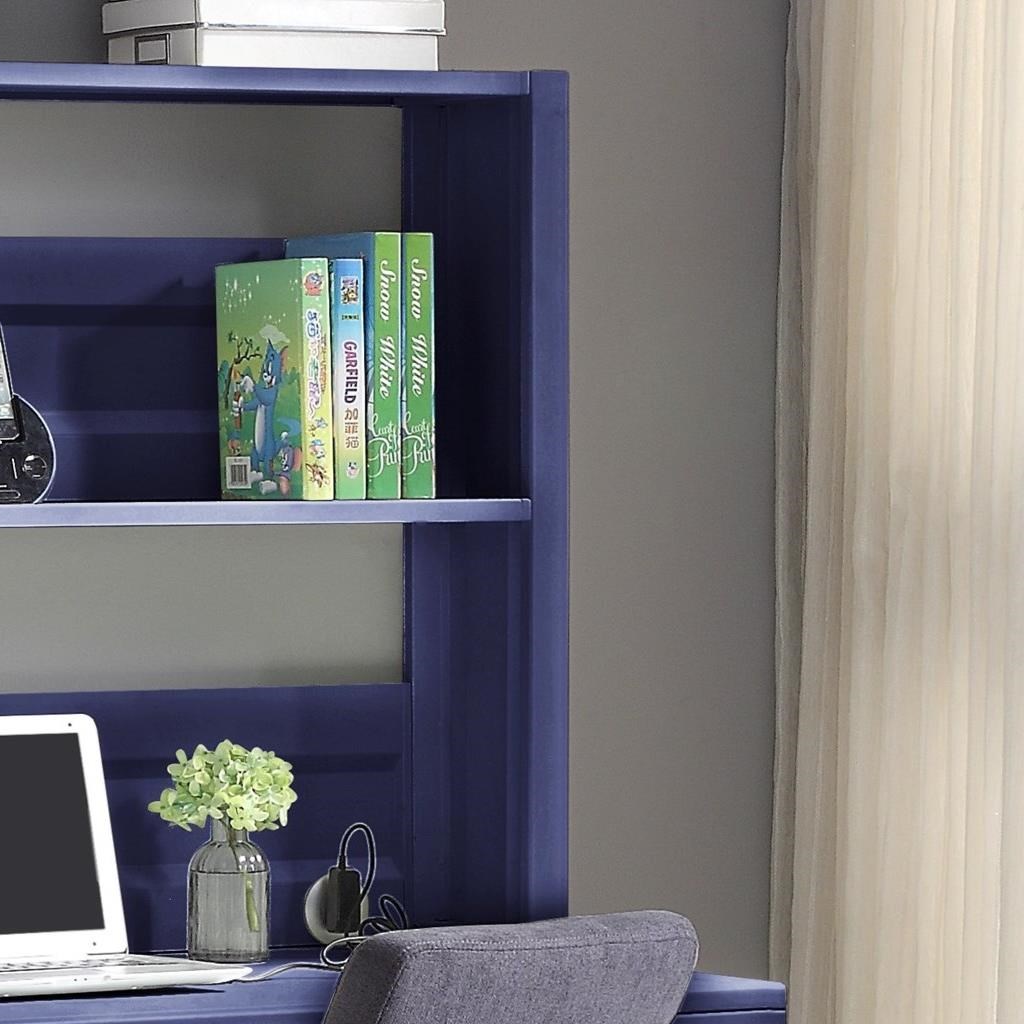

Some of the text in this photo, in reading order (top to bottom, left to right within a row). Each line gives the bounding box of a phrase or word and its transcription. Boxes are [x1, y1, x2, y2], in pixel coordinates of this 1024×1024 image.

[343, 341, 359, 404] GARFIELD
[380, 260, 396, 400] Snow White
[411, 258, 428, 398] Snow White
